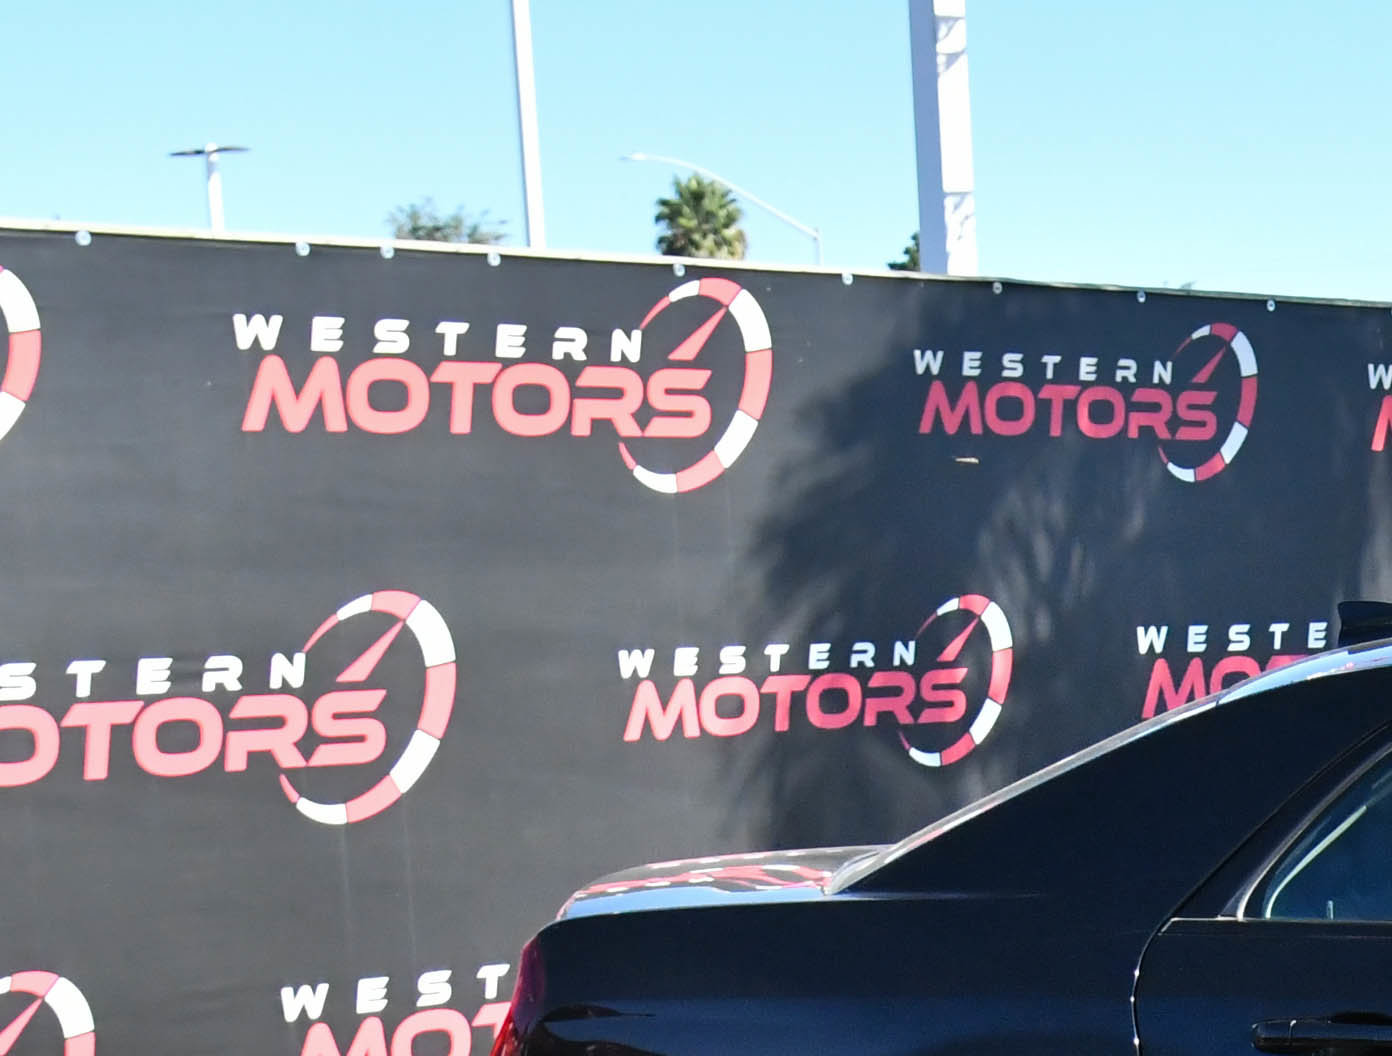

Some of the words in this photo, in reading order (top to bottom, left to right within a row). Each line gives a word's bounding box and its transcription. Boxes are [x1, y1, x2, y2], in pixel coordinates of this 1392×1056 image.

[233, 314, 642, 363] WESTERN
[914, 349, 1173, 385] WESTERN
[241, 354, 713, 438] MOTORS
[918, 379, 1218, 441] MOTORS
[618, 640, 917, 680] WESTERN
[623, 667, 969, 744] MOTORS
